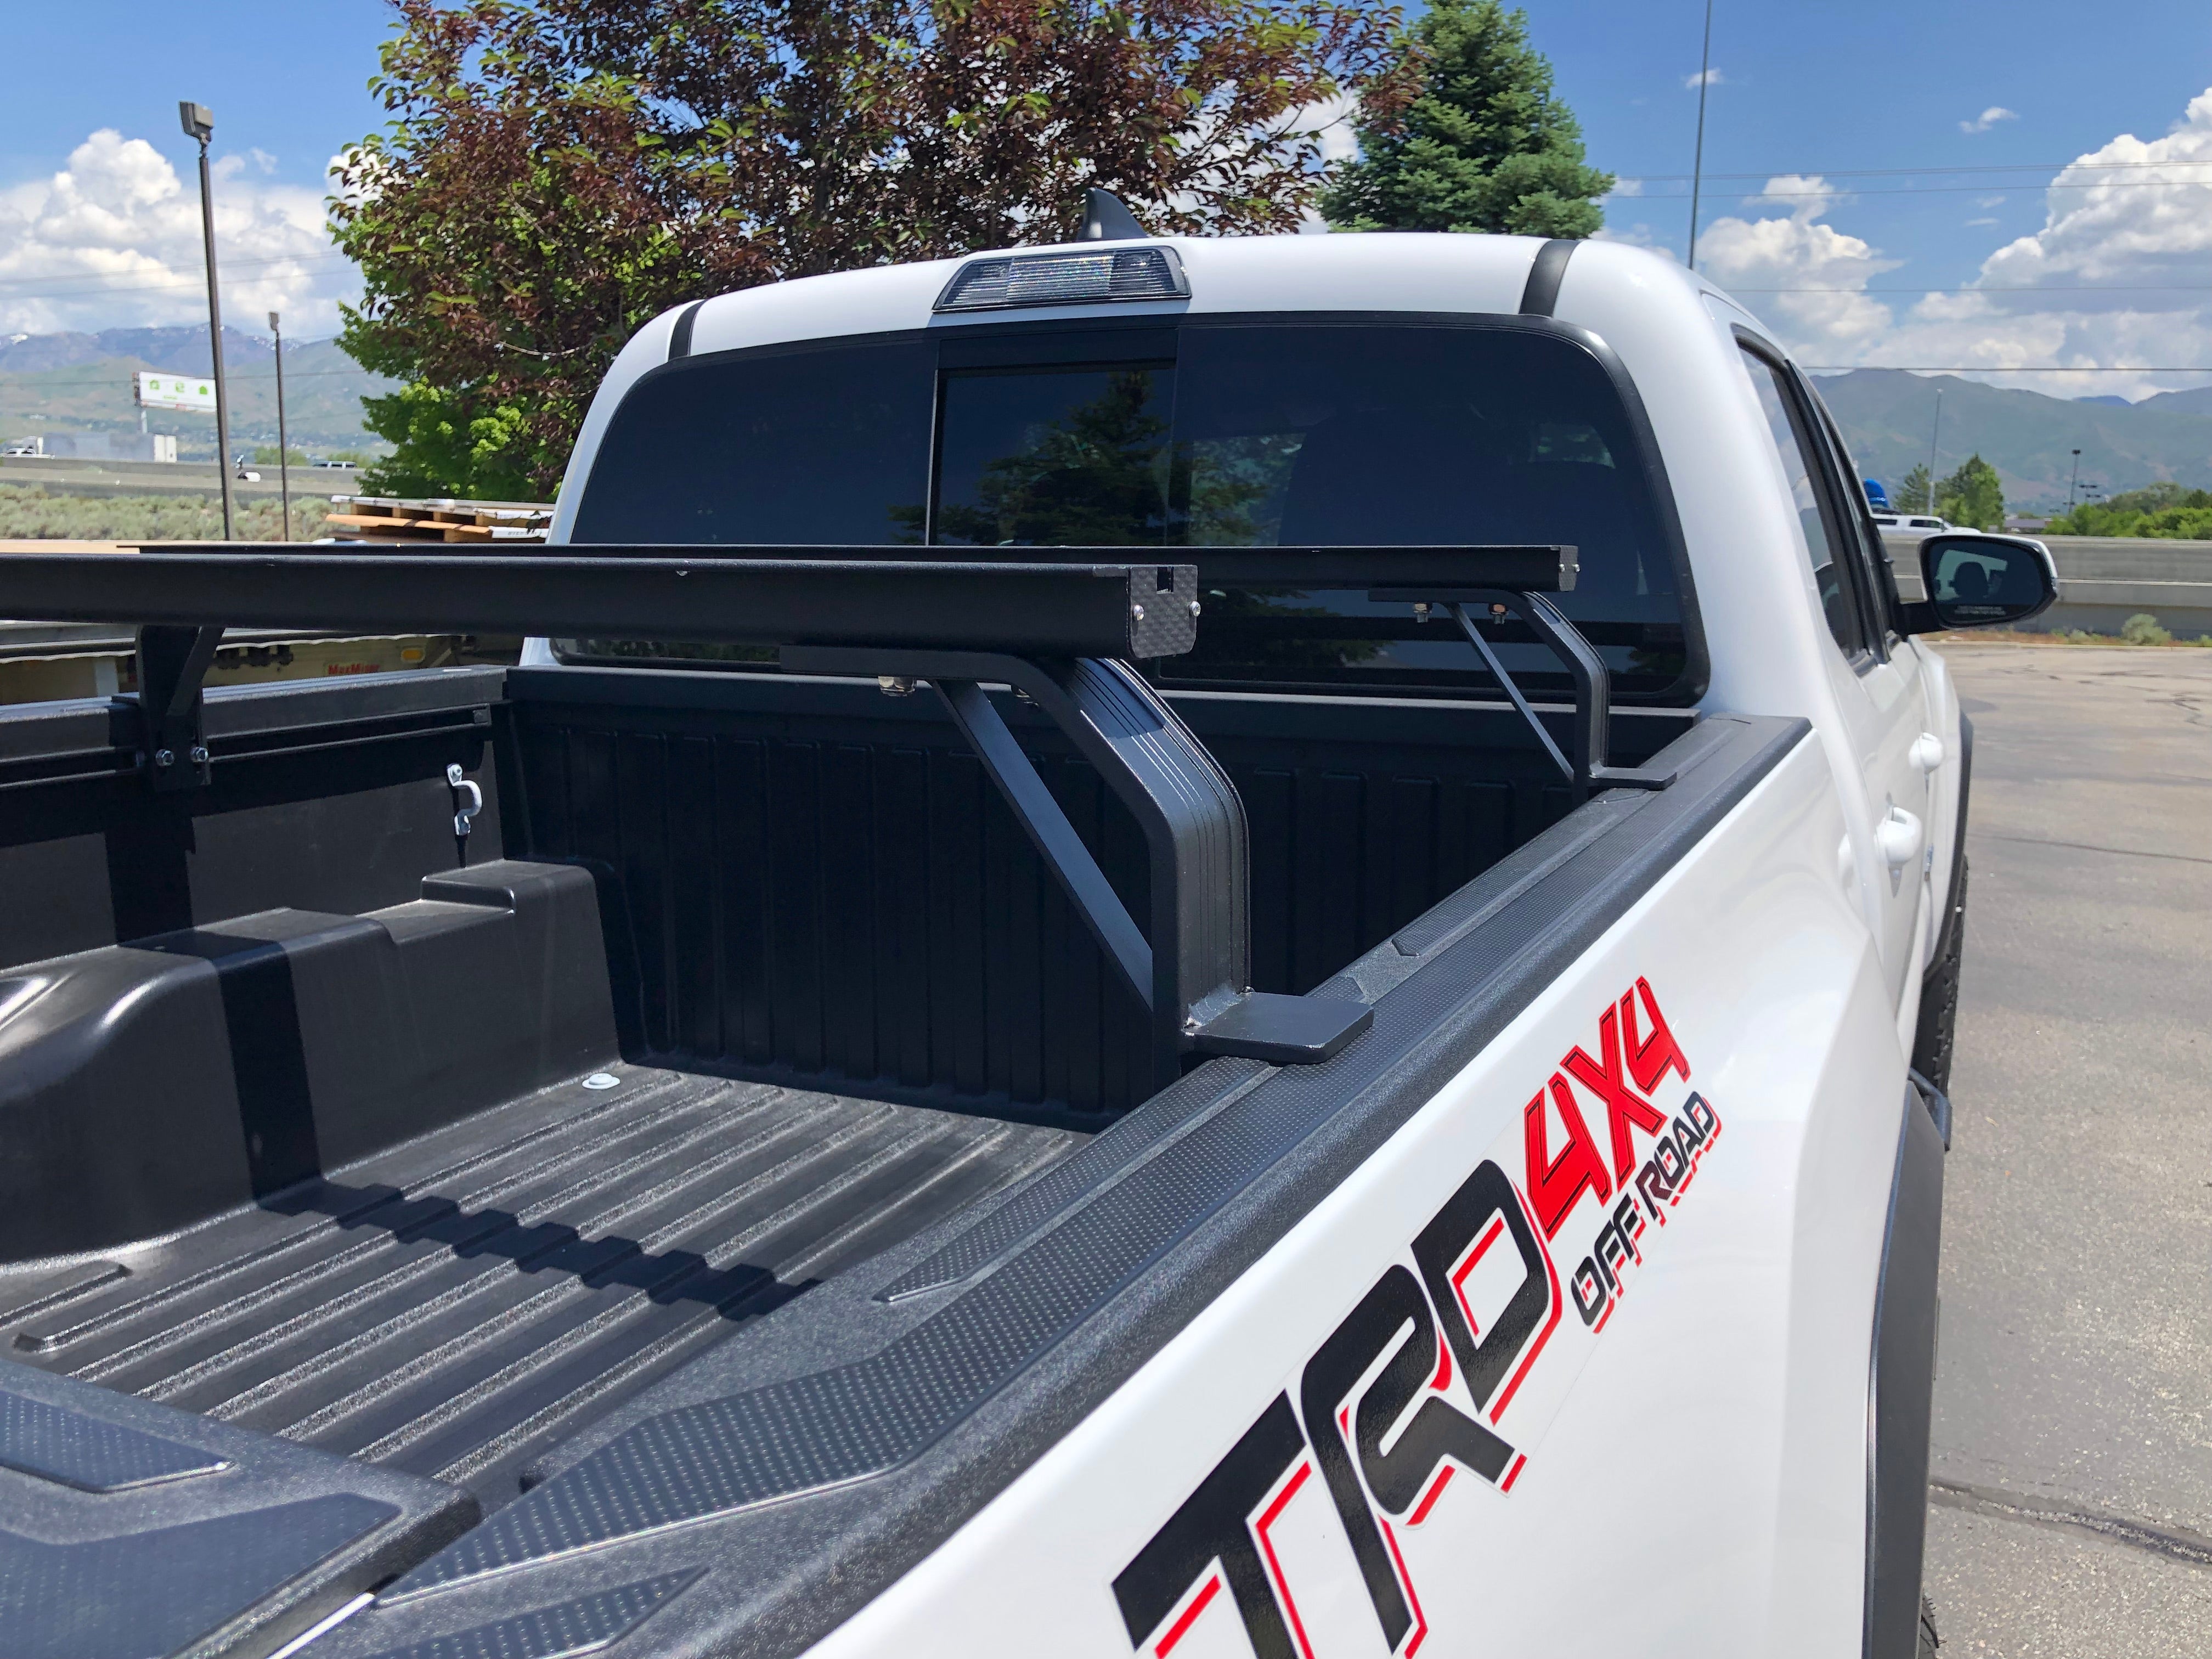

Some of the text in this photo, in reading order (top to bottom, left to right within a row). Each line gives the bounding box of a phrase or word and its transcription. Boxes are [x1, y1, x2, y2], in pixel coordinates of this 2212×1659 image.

[1571, 1091, 1719, 1331] OFF ROAD
[1110, 1159, 1561, 1659] TRD
